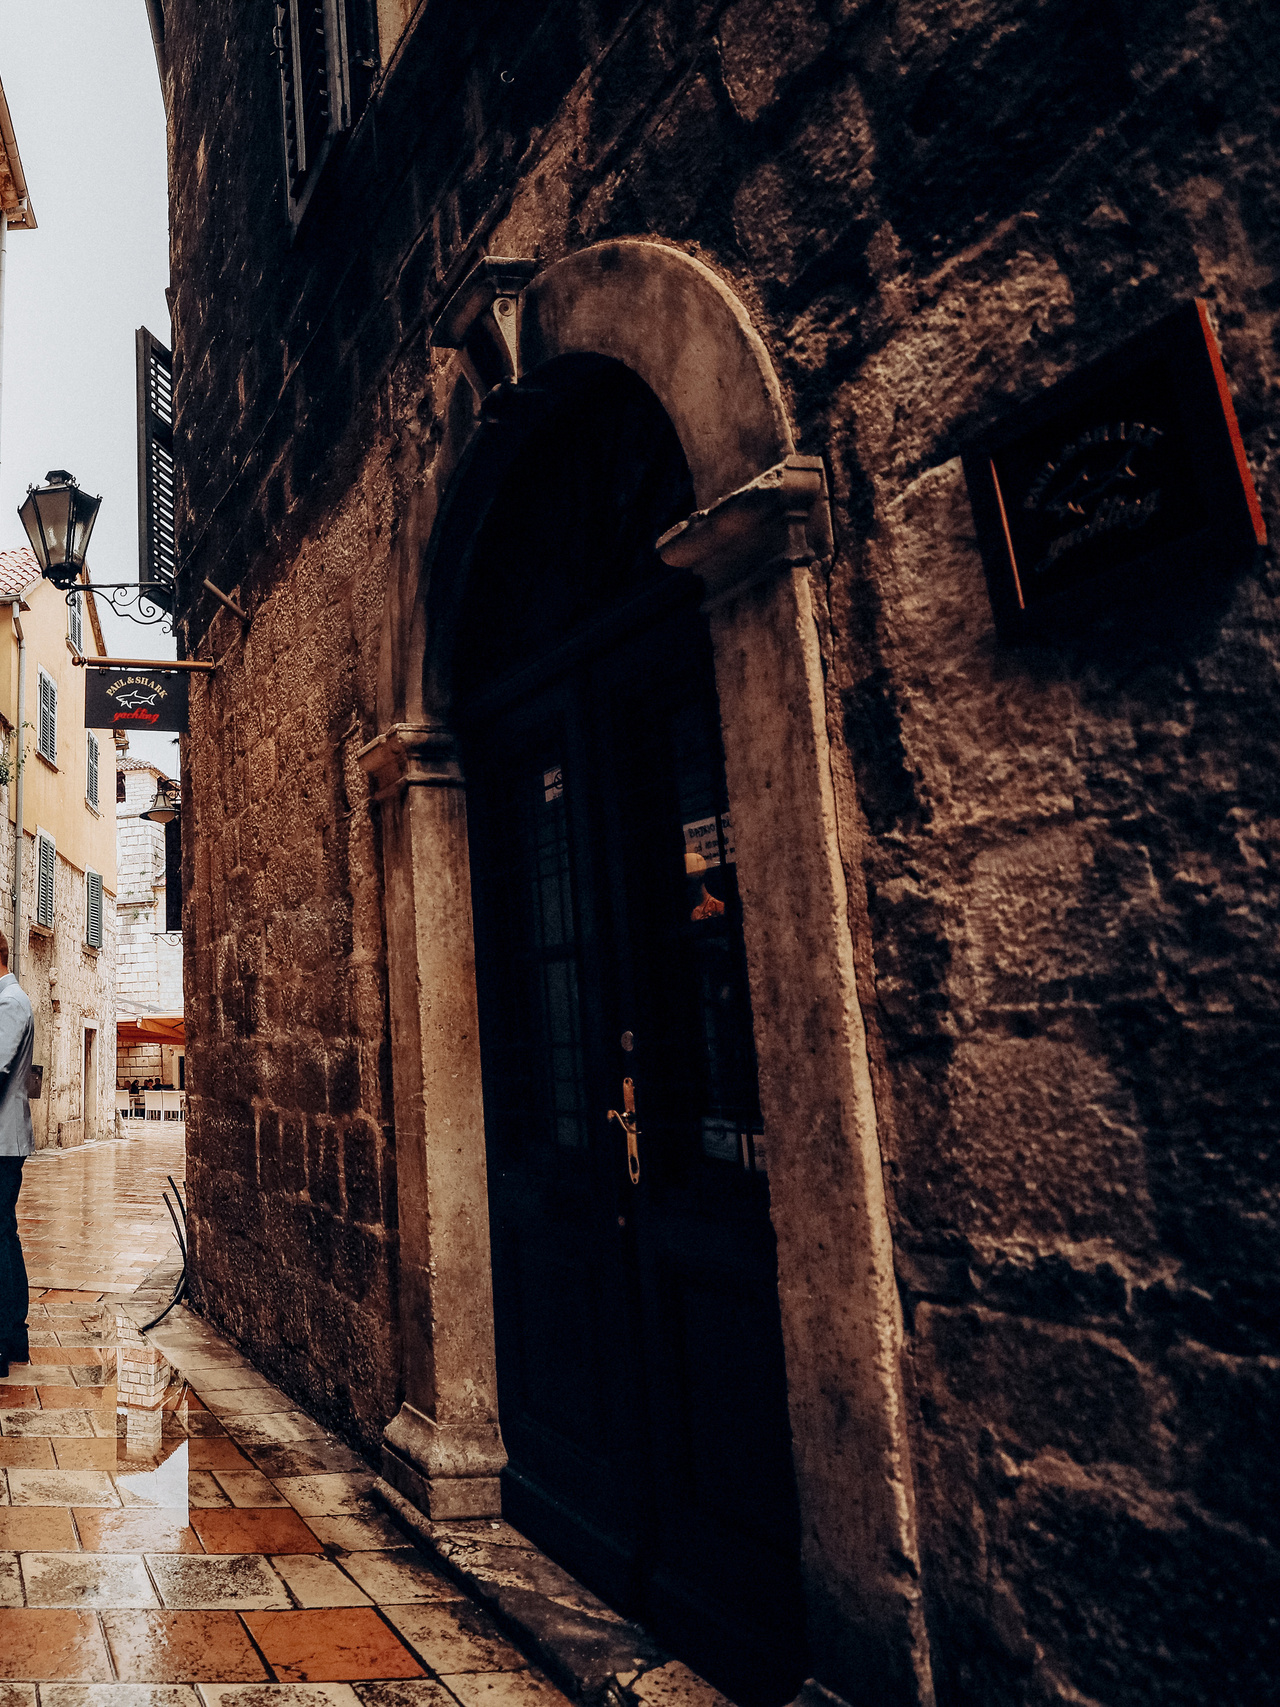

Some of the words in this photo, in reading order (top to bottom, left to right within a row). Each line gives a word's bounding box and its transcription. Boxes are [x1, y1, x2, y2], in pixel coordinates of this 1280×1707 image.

[105, 679, 127, 697] PAUL
[126, 676, 135, 685] &
[135, 676, 168, 699] SHARK
[110, 707, 160, 724] yachting
